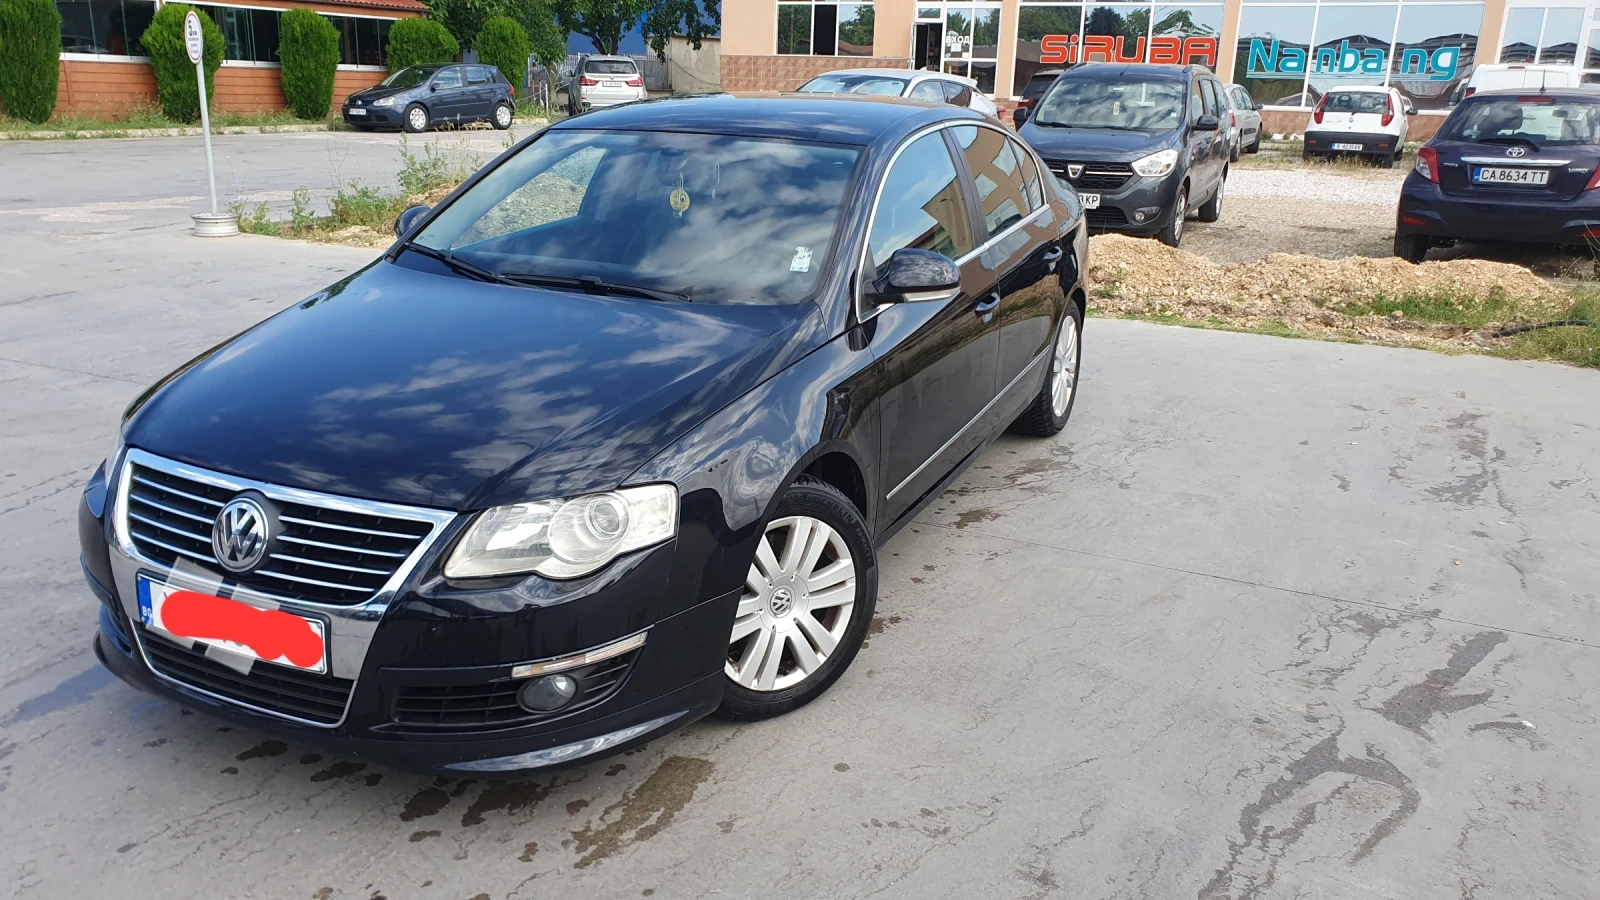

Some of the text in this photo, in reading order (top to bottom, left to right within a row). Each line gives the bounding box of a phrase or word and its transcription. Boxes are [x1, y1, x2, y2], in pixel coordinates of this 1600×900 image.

[946, 35, 970, 45] ВХОД
[1481, 169, 1496, 180] CA
[1499, 170, 1528, 182] 8634
[1531, 171, 1547, 182] TT
[1085, 194, 1098, 204] KP
[855, 527, 871, 557] PRIMACY
[142, 605, 153, 618] BG
